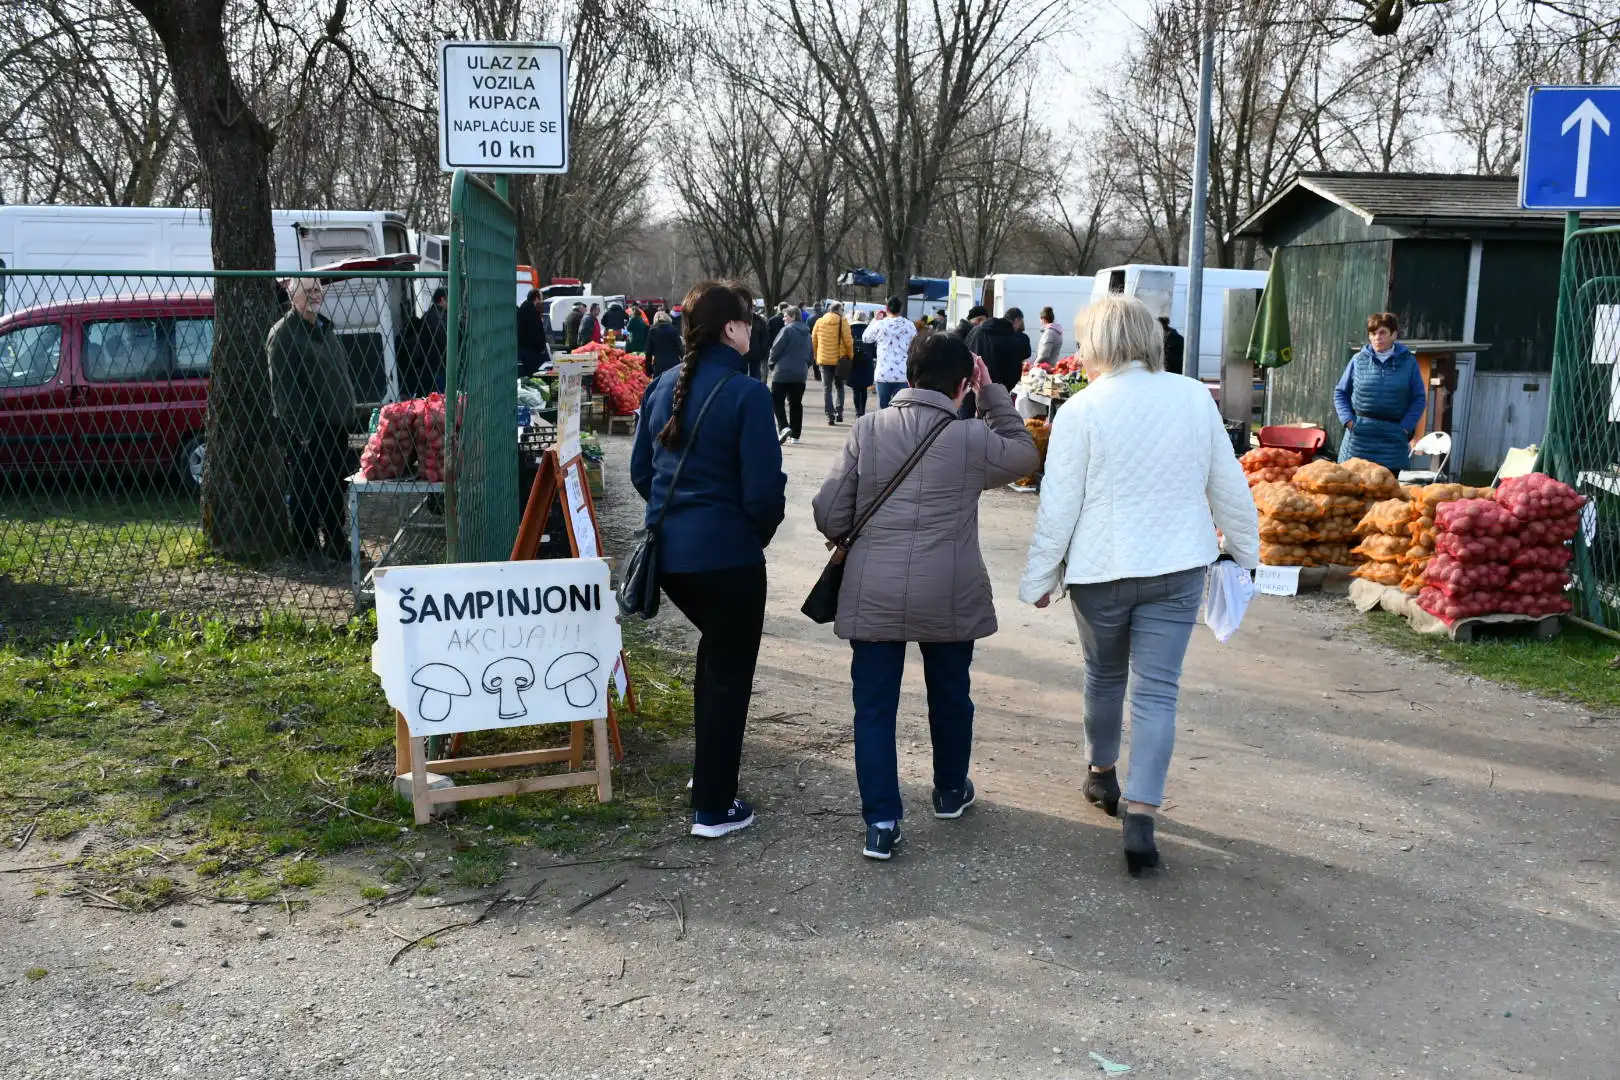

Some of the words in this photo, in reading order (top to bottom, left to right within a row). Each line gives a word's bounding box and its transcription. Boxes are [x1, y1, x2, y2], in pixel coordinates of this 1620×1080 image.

[467, 56, 512, 70] ULAZ
[518, 57, 541, 71] ZA
[472, 76, 535, 90] VOZILA
[468, 95, 541, 110] KUPACA
[539, 121, 557, 133] SE
[478, 140, 502, 158] 10
[510, 140, 535, 158] kn
[399, 584, 601, 624] ŠAMPINJONI
